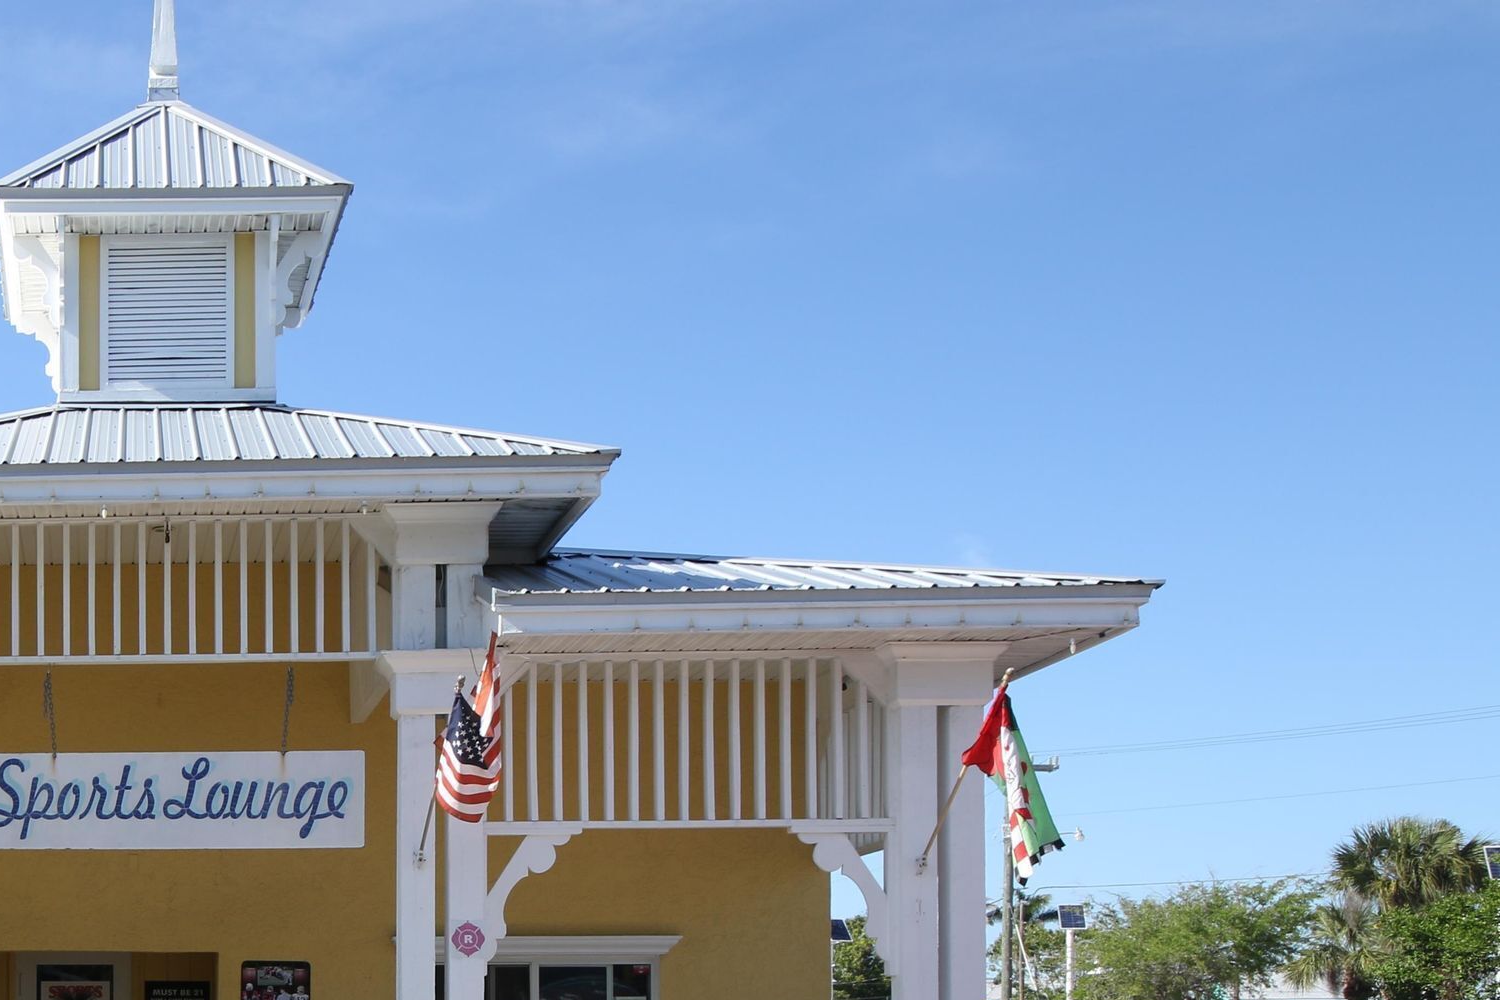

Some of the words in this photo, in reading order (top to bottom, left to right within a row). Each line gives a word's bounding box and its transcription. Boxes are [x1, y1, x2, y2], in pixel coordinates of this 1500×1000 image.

[162, 756, 350, 839] Lounge
[463, 934, 473, 944] R
[48, 985, 104, 999] SPORTS
[152, 988, 178, 997] MUST
[180, 988, 192, 997] BE
[194, 988, 204, 997] 21
